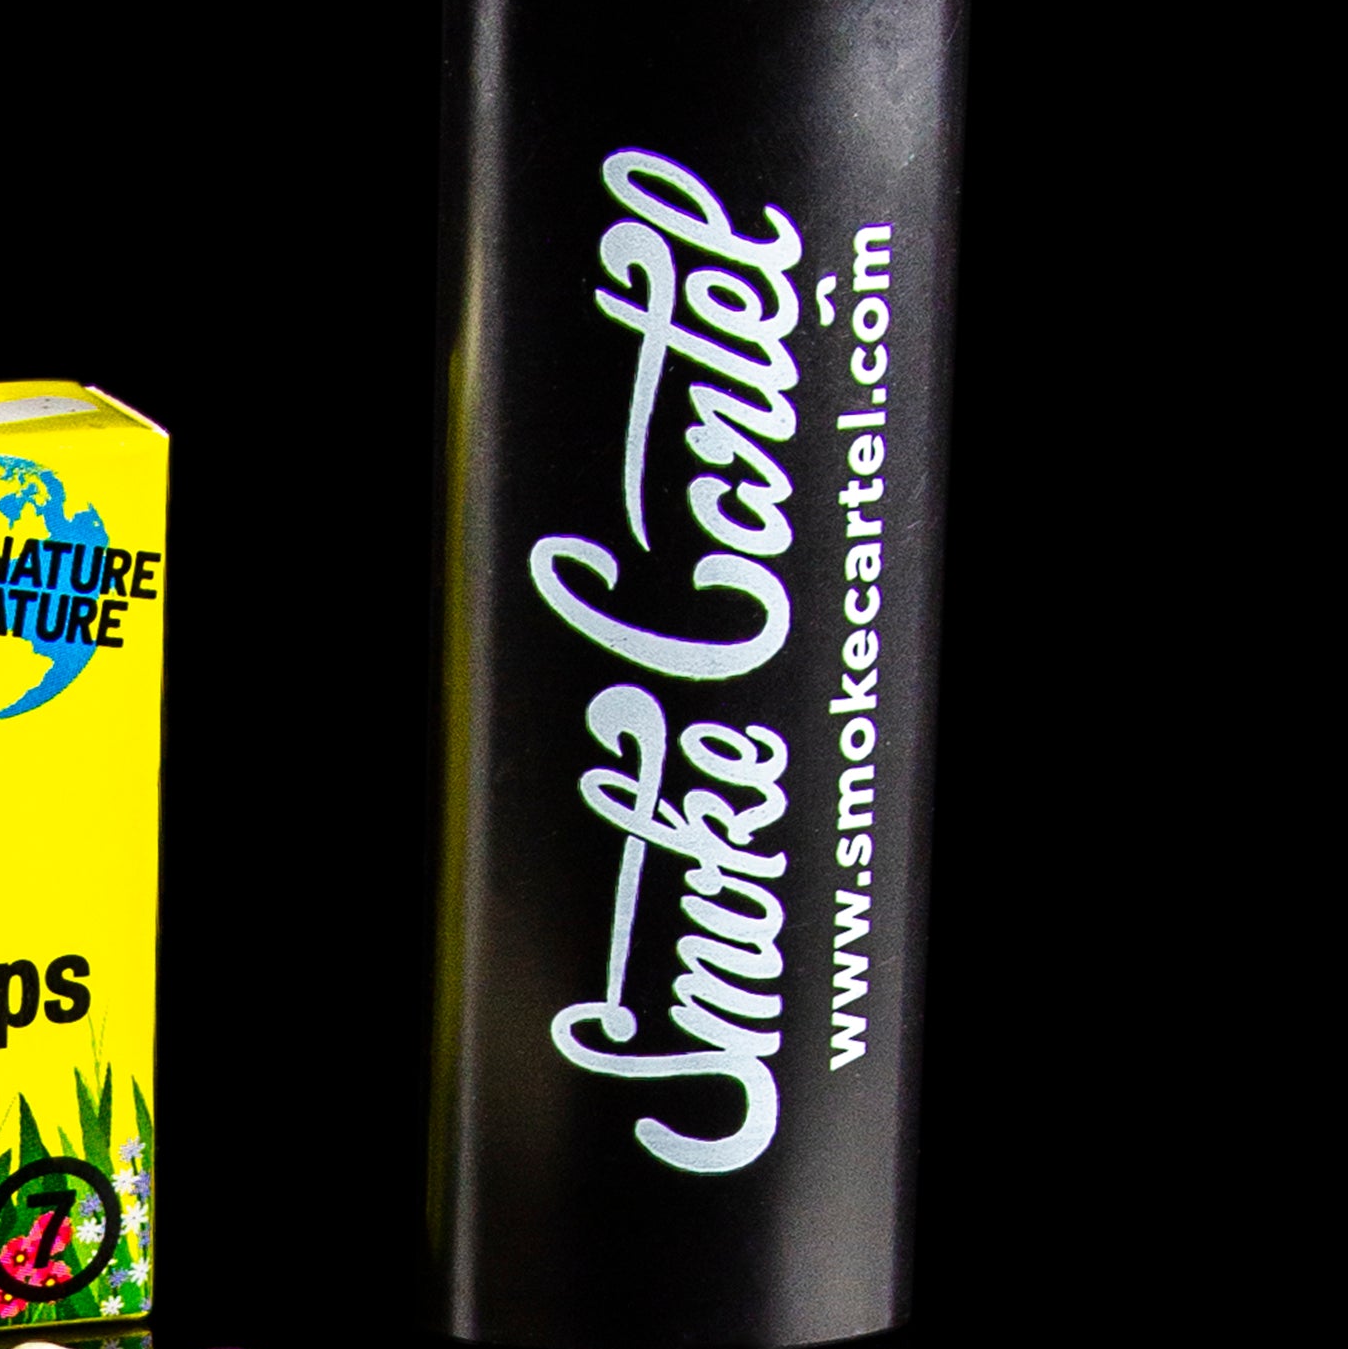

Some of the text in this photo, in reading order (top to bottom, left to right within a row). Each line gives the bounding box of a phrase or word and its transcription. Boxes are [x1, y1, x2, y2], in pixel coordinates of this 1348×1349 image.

[528, 147, 803, 1173] Smoke Cartel
[830, 223, 893, 1072] www.smokecartel.com
[26, 1189, 77, 1269] 7
